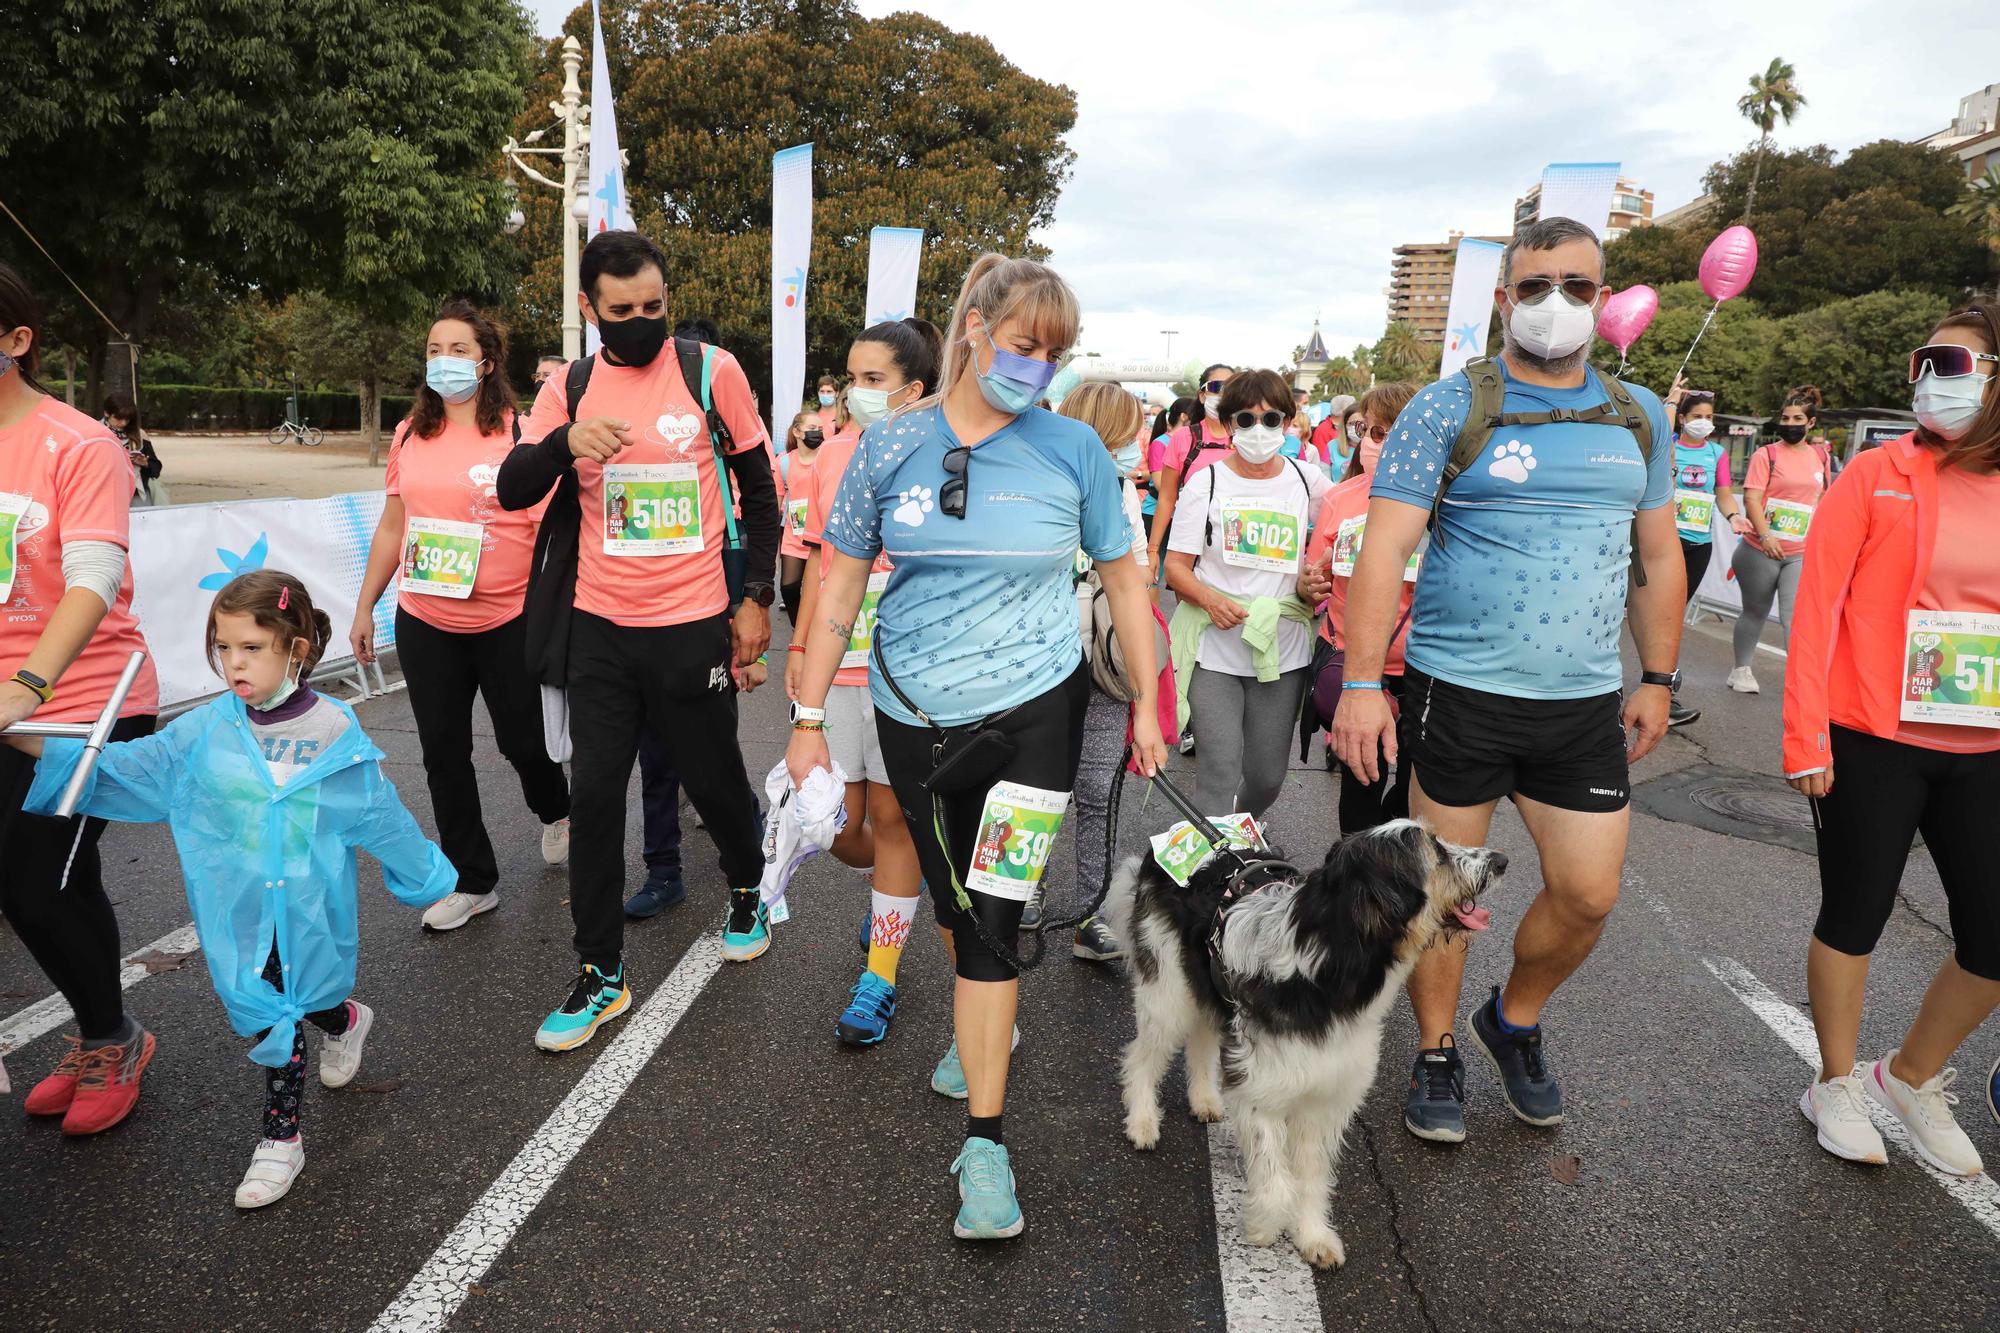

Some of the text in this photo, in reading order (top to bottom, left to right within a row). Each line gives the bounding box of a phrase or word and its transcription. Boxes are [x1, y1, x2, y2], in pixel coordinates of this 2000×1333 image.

[1122, 364, 1137, 372] 900
[1140, 364, 1153, 372] 100
[663, 424, 697, 435] aecc
[632, 496, 692, 529] 5168
[1684, 505, 1708, 520] 983
[609, 519, 623, 527] MAR
[1777, 515, 1801, 530] 984
[609, 527, 623, 535] CHA
[1246, 521, 1294, 552] 6102
[417, 545, 474, 577] 3924
[1930, 618, 1963, 628] CaixaBank
[1912, 677, 1933, 686] MAR
[1911, 685, 1932, 695] CHA
[1006, 792, 1034, 804] CaixaBank
[982, 846, 1000, 859] MAR
[979, 855, 997, 867] CHA
